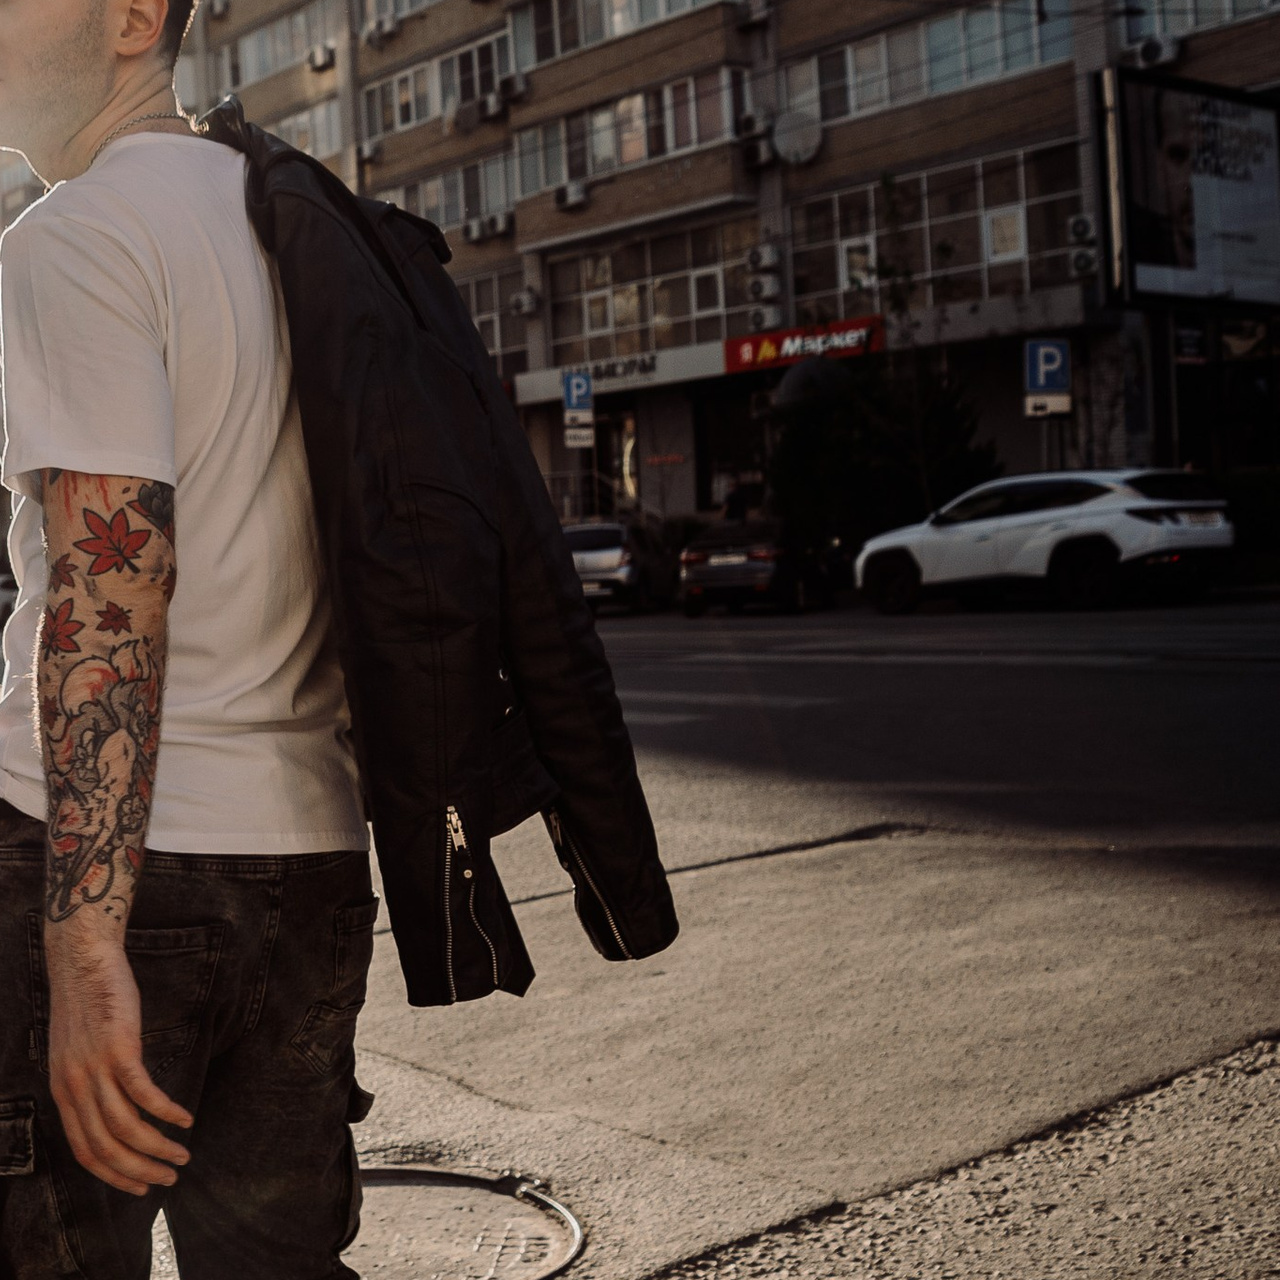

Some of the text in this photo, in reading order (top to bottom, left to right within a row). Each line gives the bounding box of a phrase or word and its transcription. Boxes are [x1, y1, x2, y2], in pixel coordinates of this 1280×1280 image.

[780, 328, 869, 358] Маркет
[1038, 346, 1062, 386] P
[570, 376, 589, 408] P
